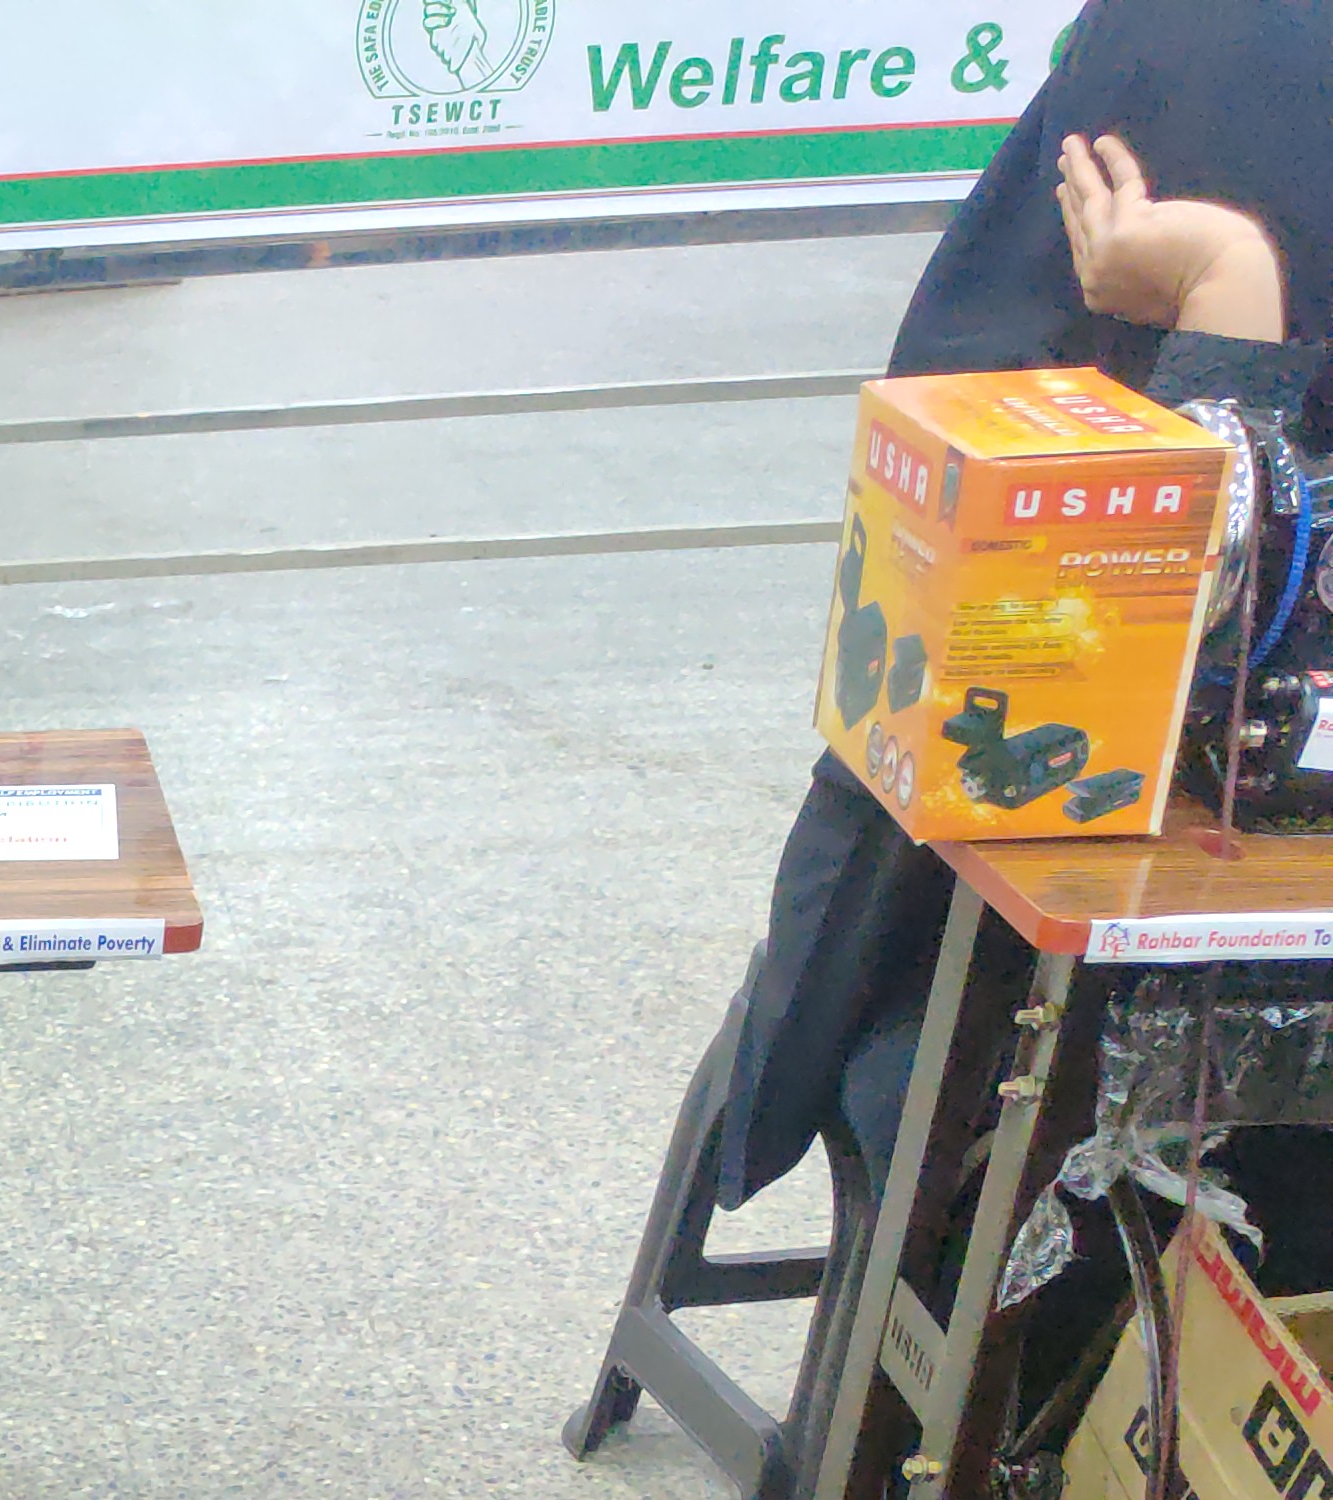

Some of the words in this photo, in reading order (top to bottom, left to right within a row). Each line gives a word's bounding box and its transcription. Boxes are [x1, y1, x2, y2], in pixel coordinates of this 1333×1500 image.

[364, 25, 379, 65] SAFA
[510, 38, 542, 84] TRUST
[586, 34, 916, 112] Welfare
[950, 21, 1010, 93] &
[392, 98, 502, 125] TSEWCT
[1052, 395, 1144, 433] USHA
[870, 430, 928, 505] USHA
[1014, 485, 1182, 518] USHA
[1058, 548, 1191, 577] POWER
[2, 936, 14, 951] &
[19, 934, 92, 952] Eliminate
[97, 934, 156, 954] Poverty
[1137, 931, 1202, 949] Rahbar
[1207, 929, 1307, 948] Foundation
[1313, 929, 1332, 945] To
